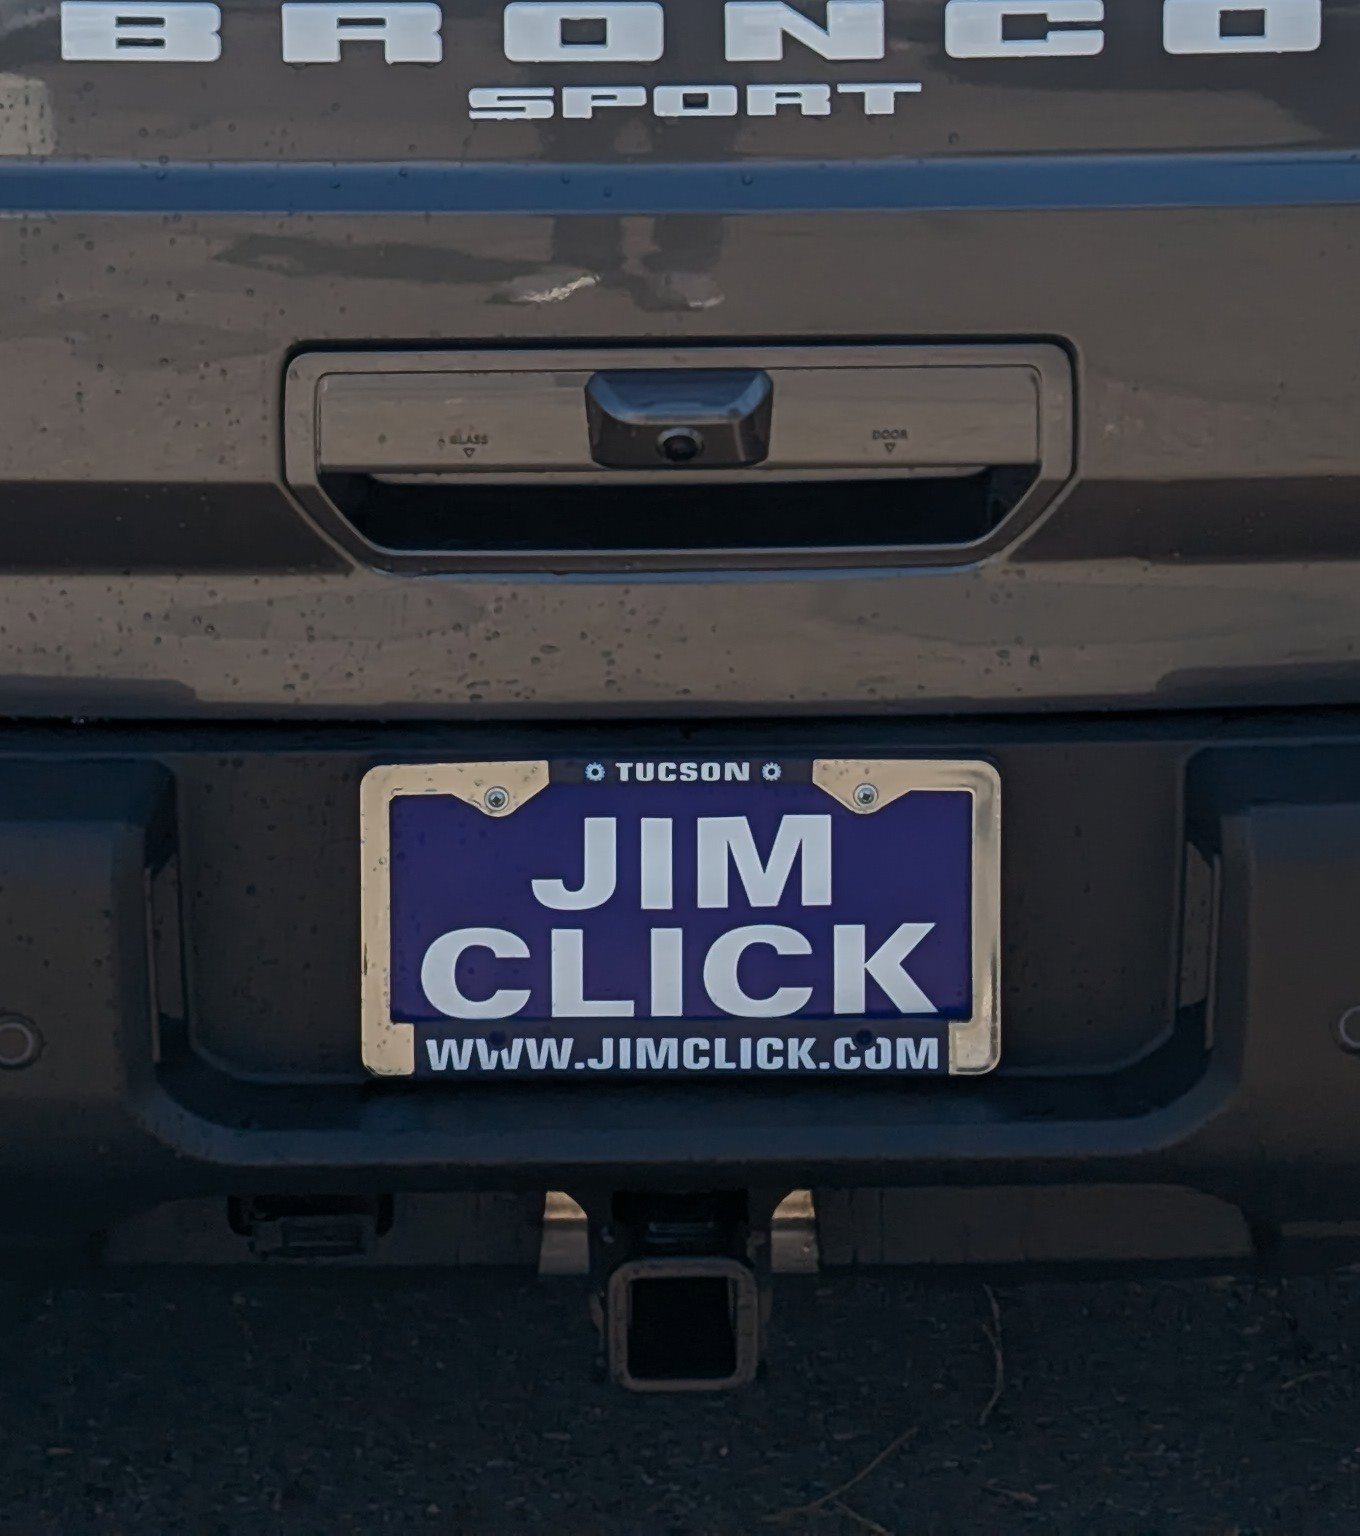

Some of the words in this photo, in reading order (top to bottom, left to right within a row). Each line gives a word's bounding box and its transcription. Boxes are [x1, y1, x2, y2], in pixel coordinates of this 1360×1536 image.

[467, 82, 923, 121] SPORT
[872, 429, 908, 440] DOOR
[615, 761, 750, 783] TUCSON
[531, 814, 833, 911] JIM
[420, 922, 938, 1020] CLICK
[425, 1037, 939, 1072] WWW.JIMCLICK.COM
